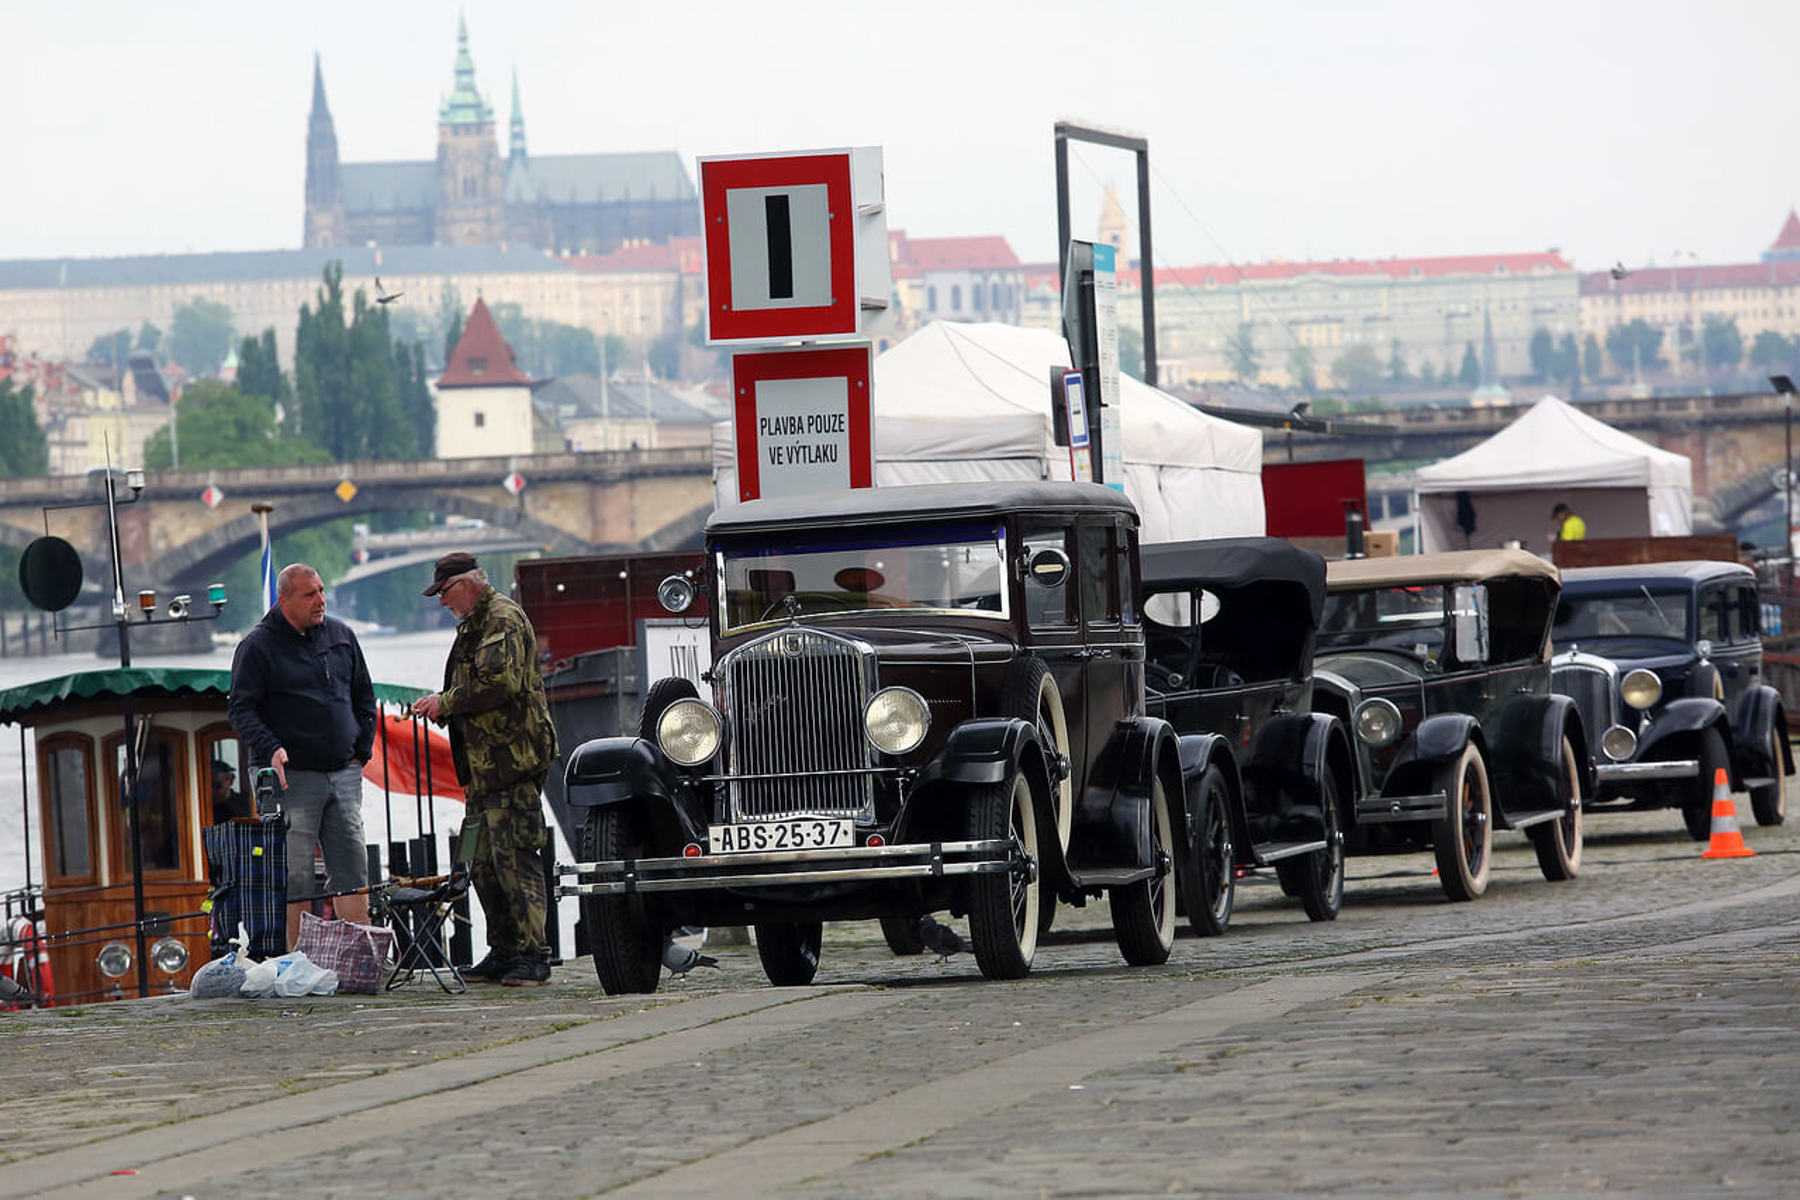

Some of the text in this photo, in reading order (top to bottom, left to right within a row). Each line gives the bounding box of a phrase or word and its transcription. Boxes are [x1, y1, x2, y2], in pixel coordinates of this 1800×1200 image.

[760, 413, 845, 436] PLAVBA POUZE
[769, 440, 838, 465] VE VÝTLAKU
